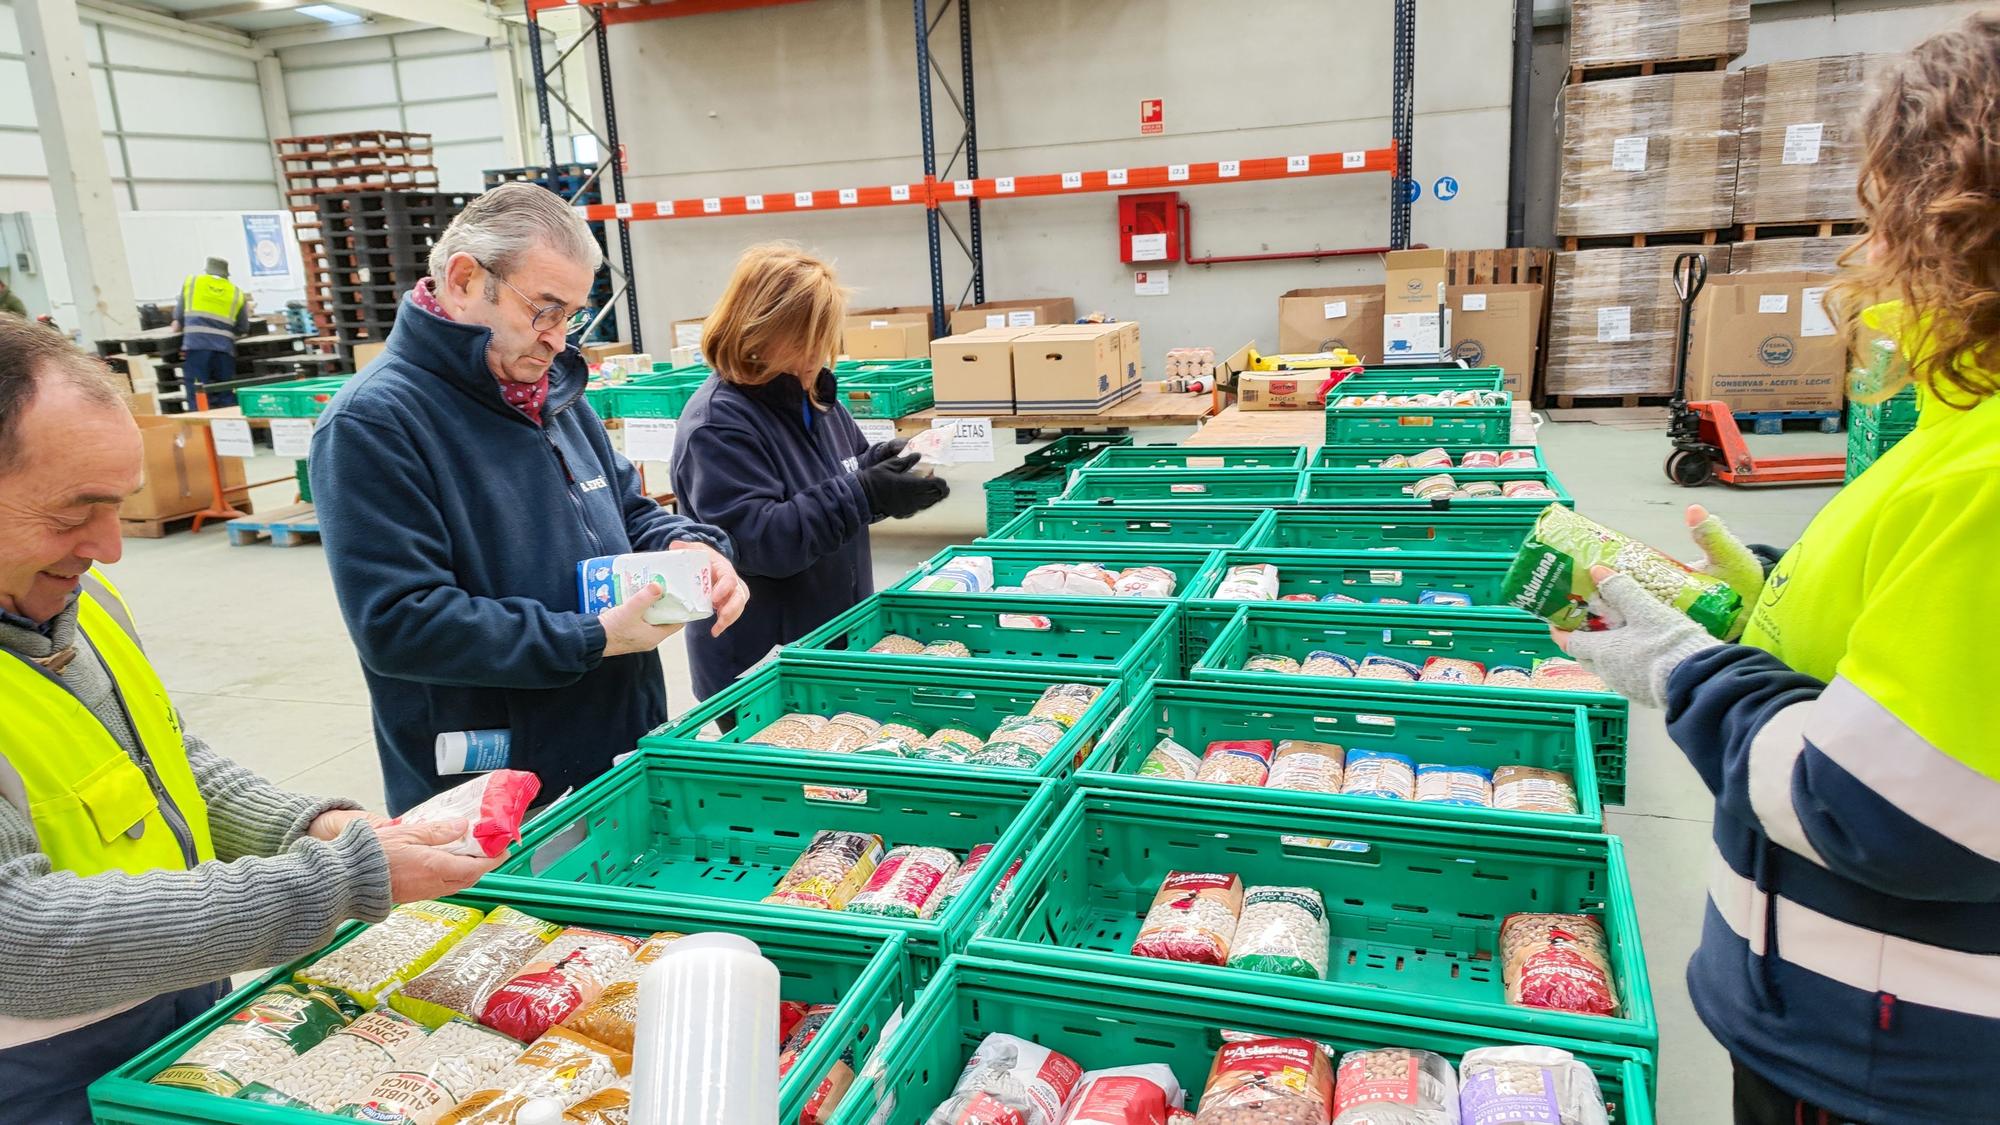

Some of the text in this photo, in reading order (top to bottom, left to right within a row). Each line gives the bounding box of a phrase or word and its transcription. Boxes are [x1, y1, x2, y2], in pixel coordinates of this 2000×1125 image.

[1714, 380, 1764, 388] CONSERVAS
[1769, 379, 1798, 387] ACEITE
[1805, 378, 1832, 386] LECHE
[702, 567, 711, 595] SOS
[1124, 581, 1149, 592] SOS
[1516, 552, 1557, 608] Asturiana
[1234, 1045, 1308, 1058] Asturiana
[370, 1087, 429, 1111] ALUBIA
[381, 1078, 441, 1106] BLANCA
[1340, 1092, 1409, 1108] ALUBIA
